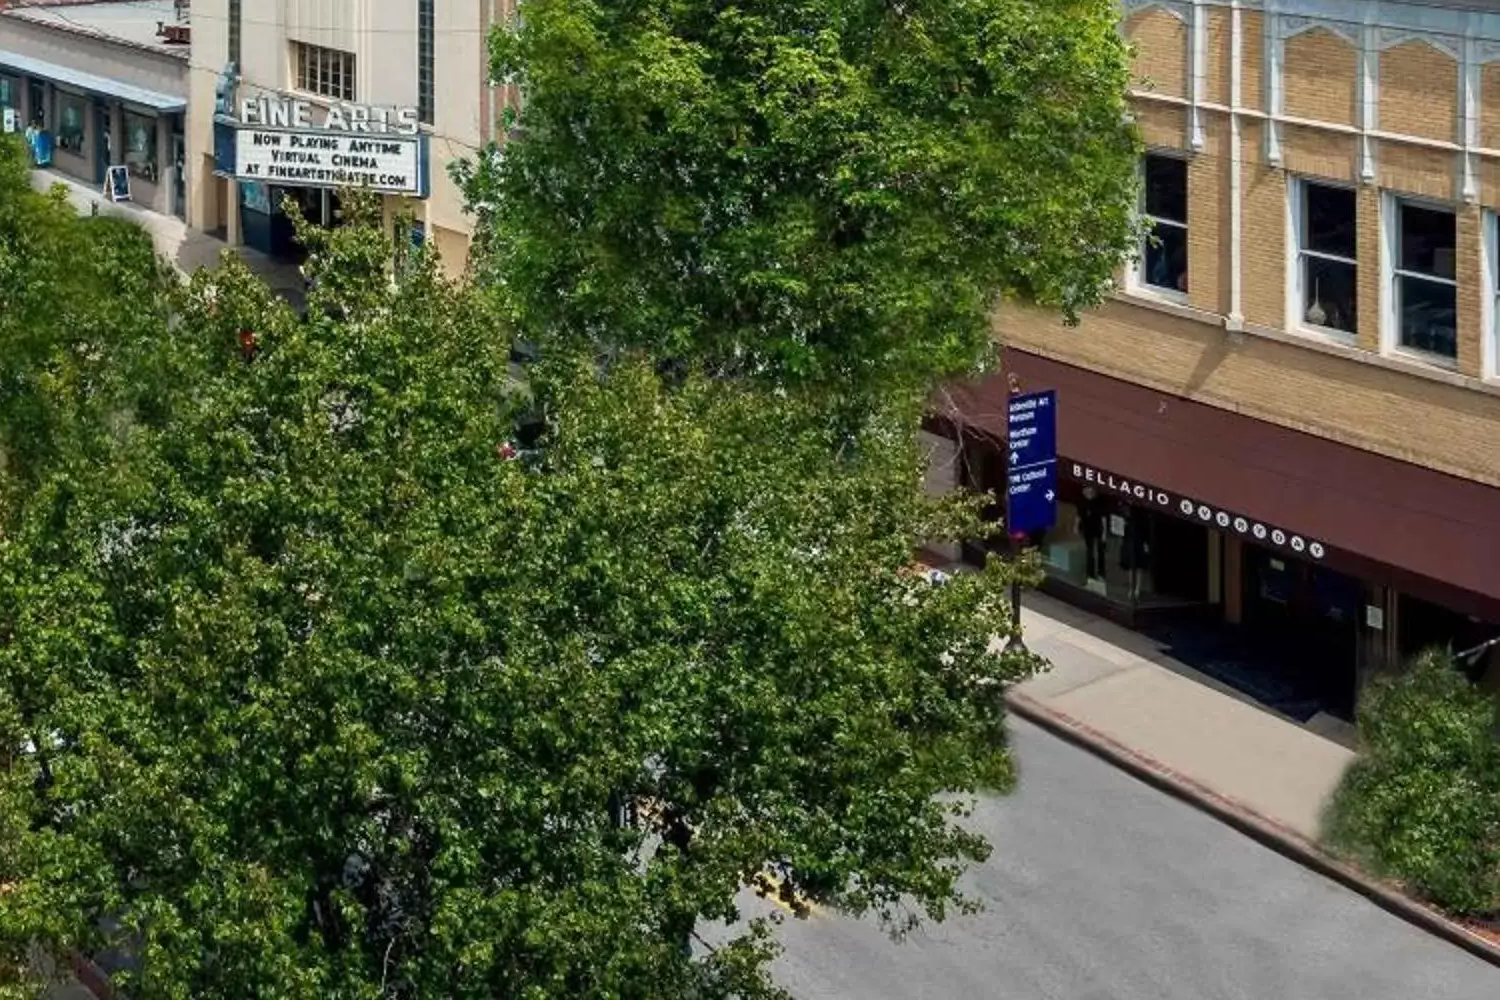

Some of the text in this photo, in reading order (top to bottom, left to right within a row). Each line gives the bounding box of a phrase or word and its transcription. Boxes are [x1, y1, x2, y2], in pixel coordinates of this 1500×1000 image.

[241, 99, 418, 135] FINE ARTS
[253, 133, 402, 155] NOW PLAYING ANYTIME
[246, 164, 260, 175] AT
[271, 150, 378, 169] VIRTUAL CINEMA
[1073, 464, 1325, 559] BELLAGIO EVERYDAY
